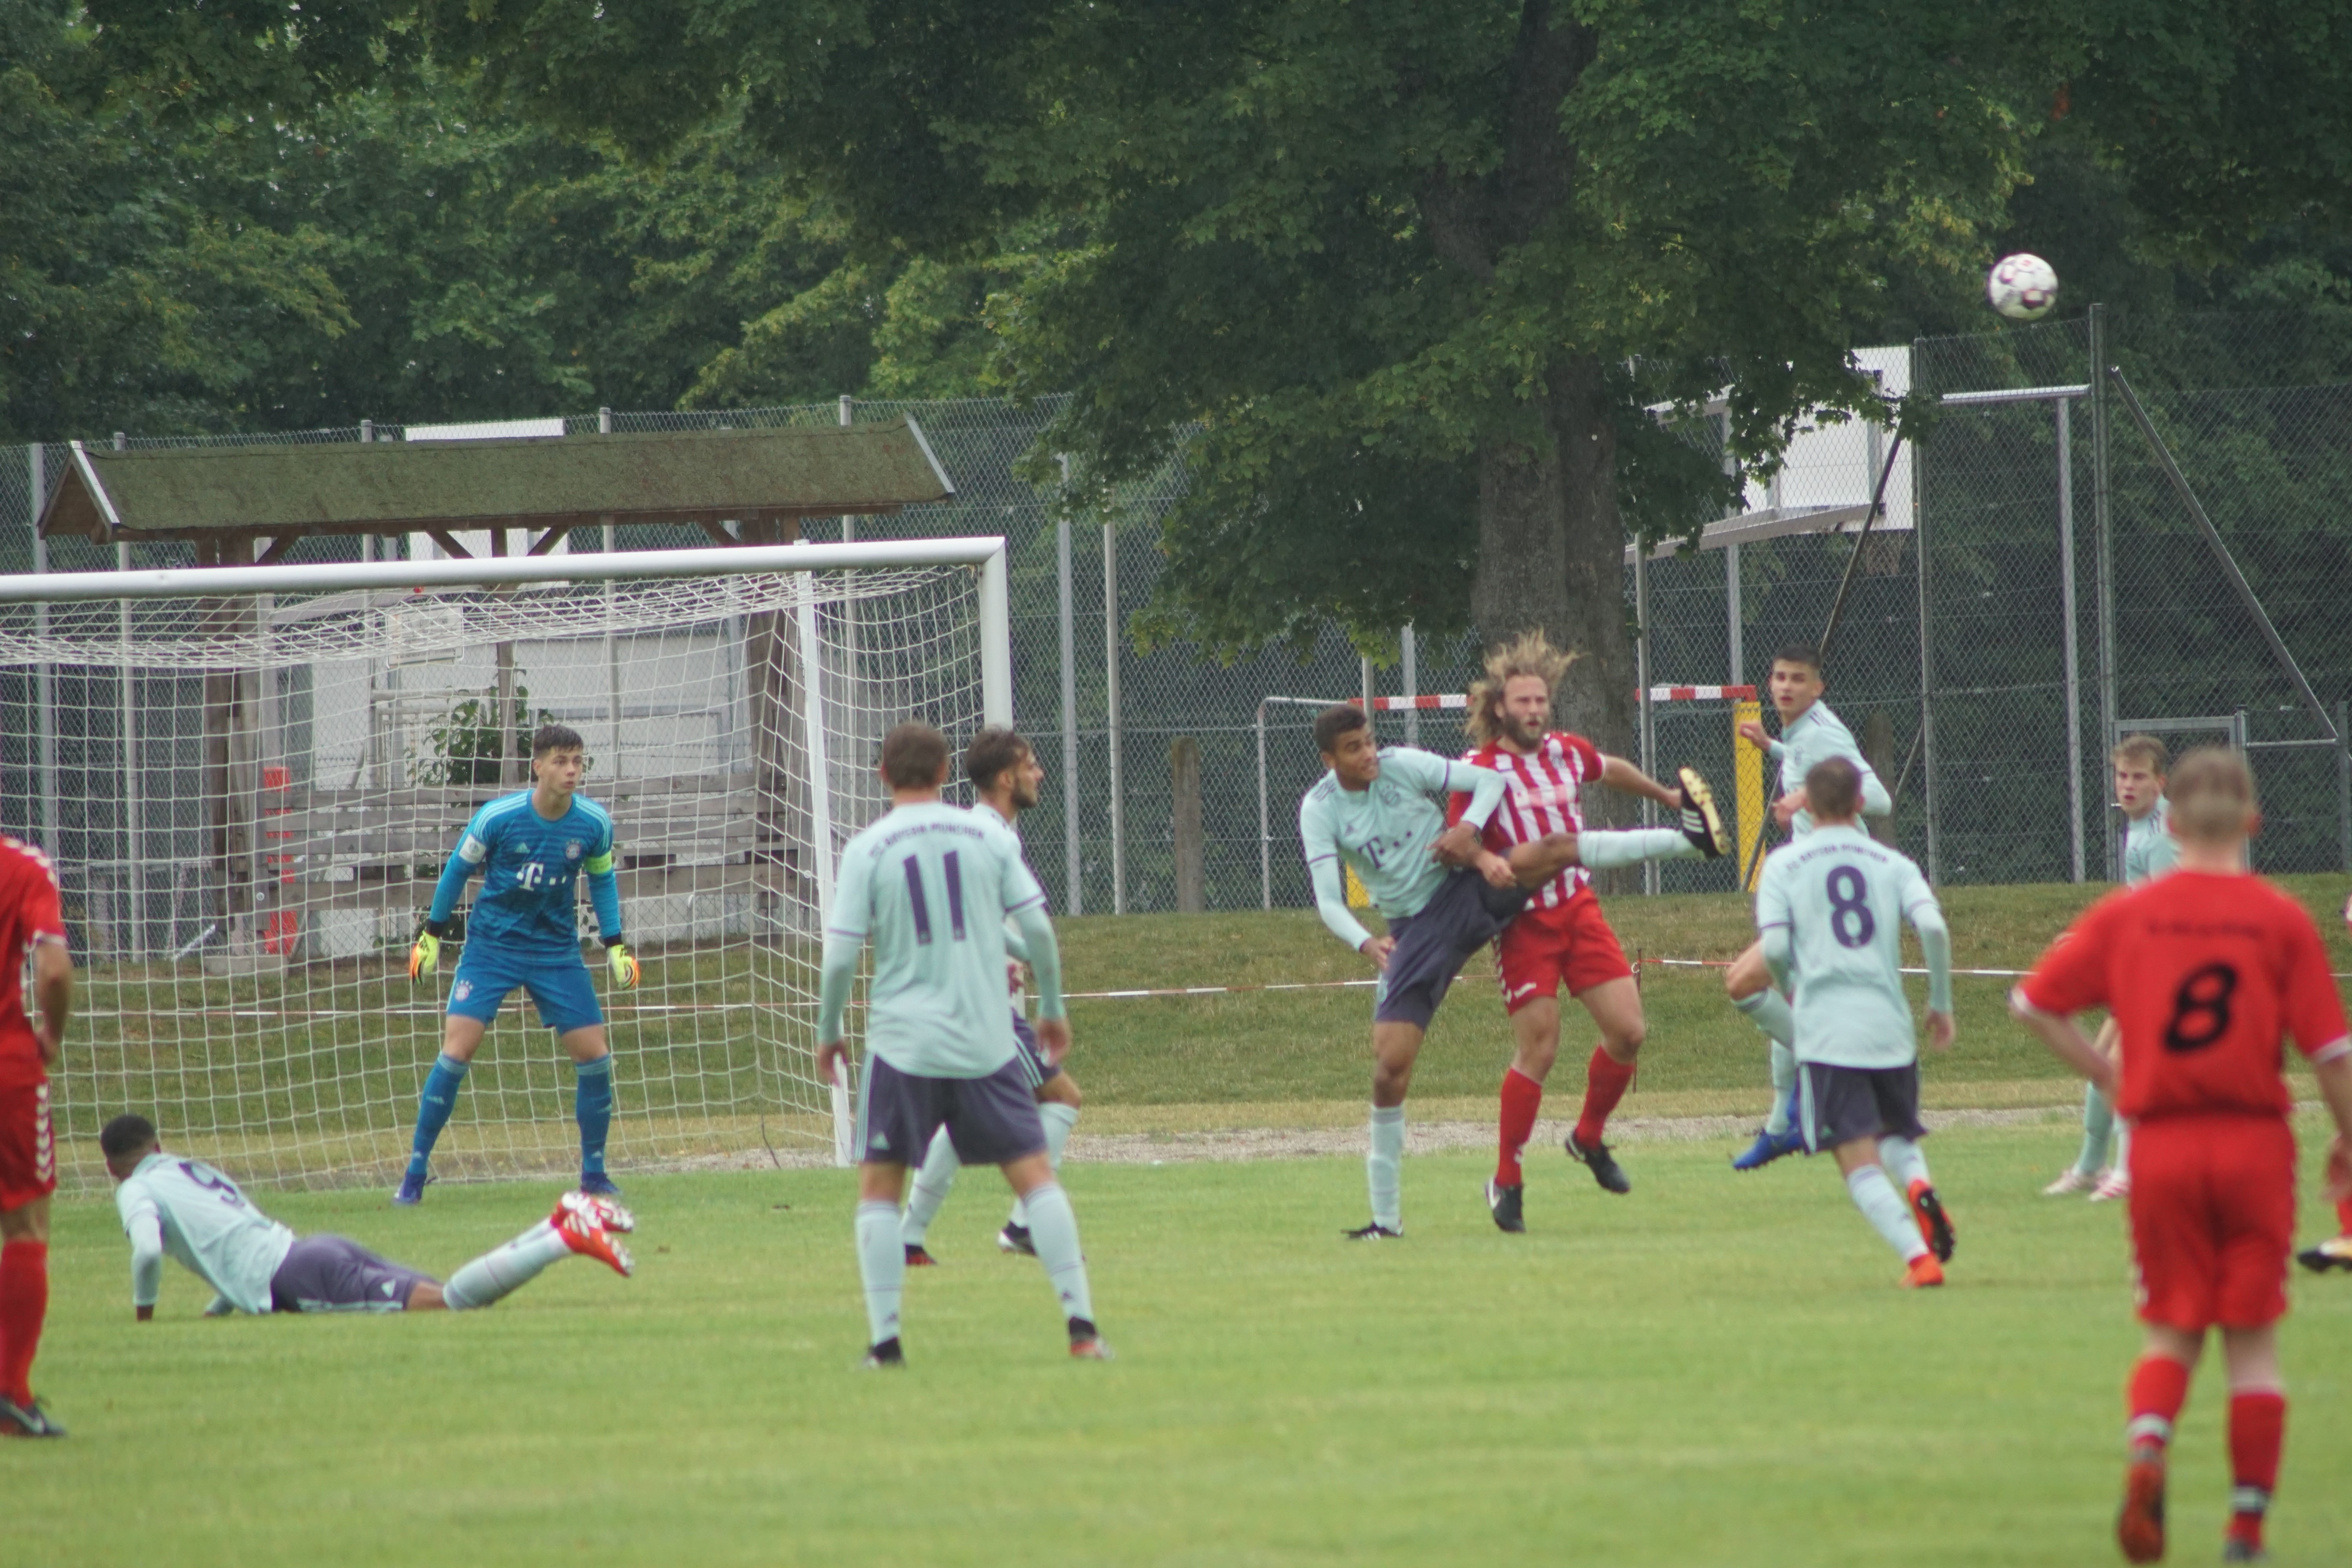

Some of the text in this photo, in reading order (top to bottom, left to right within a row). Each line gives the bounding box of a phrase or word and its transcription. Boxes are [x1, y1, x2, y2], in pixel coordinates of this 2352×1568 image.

[903, 849, 966, 947] 11
[1826, 865, 1876, 949] 8
[2163, 959, 2239, 1054] 8
[178, 1160, 245, 1209] 9
